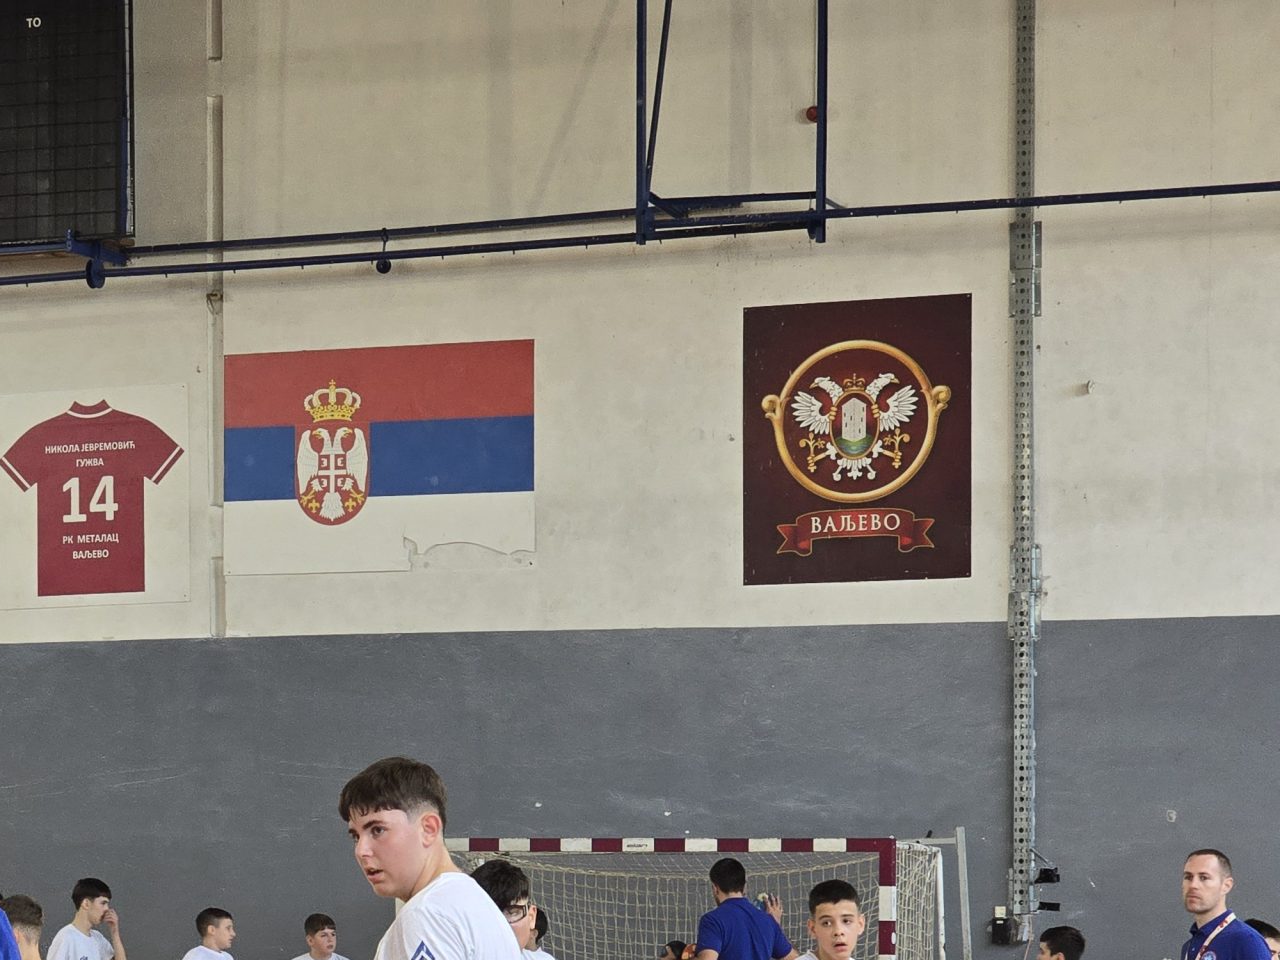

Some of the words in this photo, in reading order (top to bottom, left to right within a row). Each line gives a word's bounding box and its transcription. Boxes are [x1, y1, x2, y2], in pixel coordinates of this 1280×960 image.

[26, 17, 42, 29] TO
[45, 443, 80, 454] НИКОЛА
[81, 440, 135, 452] ЈЕВРЕМОВИЋ
[76, 457, 104, 467] ГУЖВА
[62, 475, 119, 523] 14
[810, 513, 901, 534] ВАЉЕВО
[62, 536, 74, 544] РК
[77, 533, 119, 543] МЕТАЛАЦ
[72, 549, 109, 559] ВАЉЕВО
